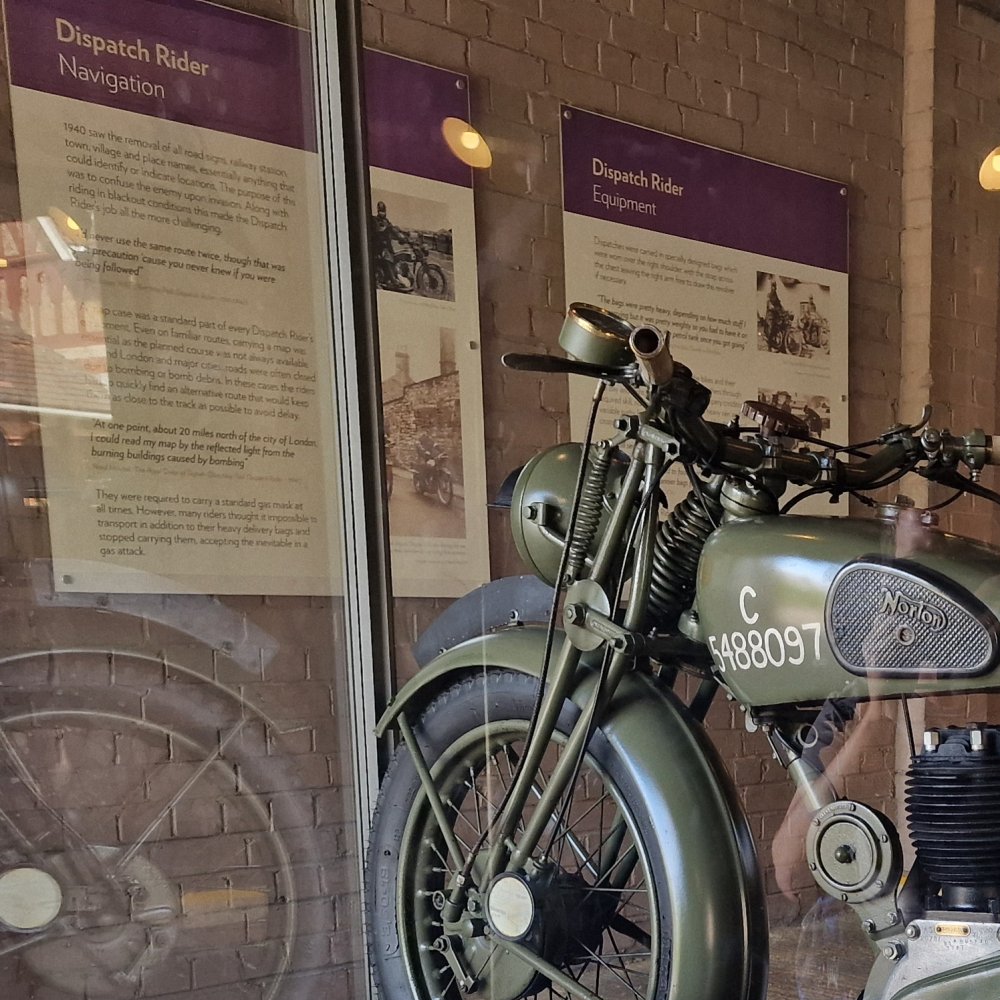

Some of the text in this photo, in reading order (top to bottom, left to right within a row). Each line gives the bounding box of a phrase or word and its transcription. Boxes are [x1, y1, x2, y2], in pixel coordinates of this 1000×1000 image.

[56, 17, 209, 76] Dispatch Rider
[58, 52, 165, 99] Navigation
[592, 157, 684, 196] Dispatch Rider
[593, 184, 657, 216] Equipment
[96, 434, 120, 444] could
[121, 436, 141, 445] read
[158, 441, 177, 450] map
[190, 440, 204, 450] the
[206, 442, 242, 454] reflected
[243, 444, 260, 457] light
[262, 446, 280, 457] from
[282, 448, 295, 458] the
[106, 419, 124, 430] one
[125, 423, 151, 433] point,
[152, 424, 177, 434] about
[192, 427, 214, 438] miles
[215, 430, 237, 439] north
[248, 432, 261, 441] the
[262, 435, 276, 445] city
[91, 448, 124, 460] burning
[126, 450, 165, 463] buildings
[166, 454, 196, 463] caused
[197, 454, 208, 466] by
[738, 585, 760, 625] C
[880, 586, 947, 633] Norton
[708, 622, 821, 672] 5488097
